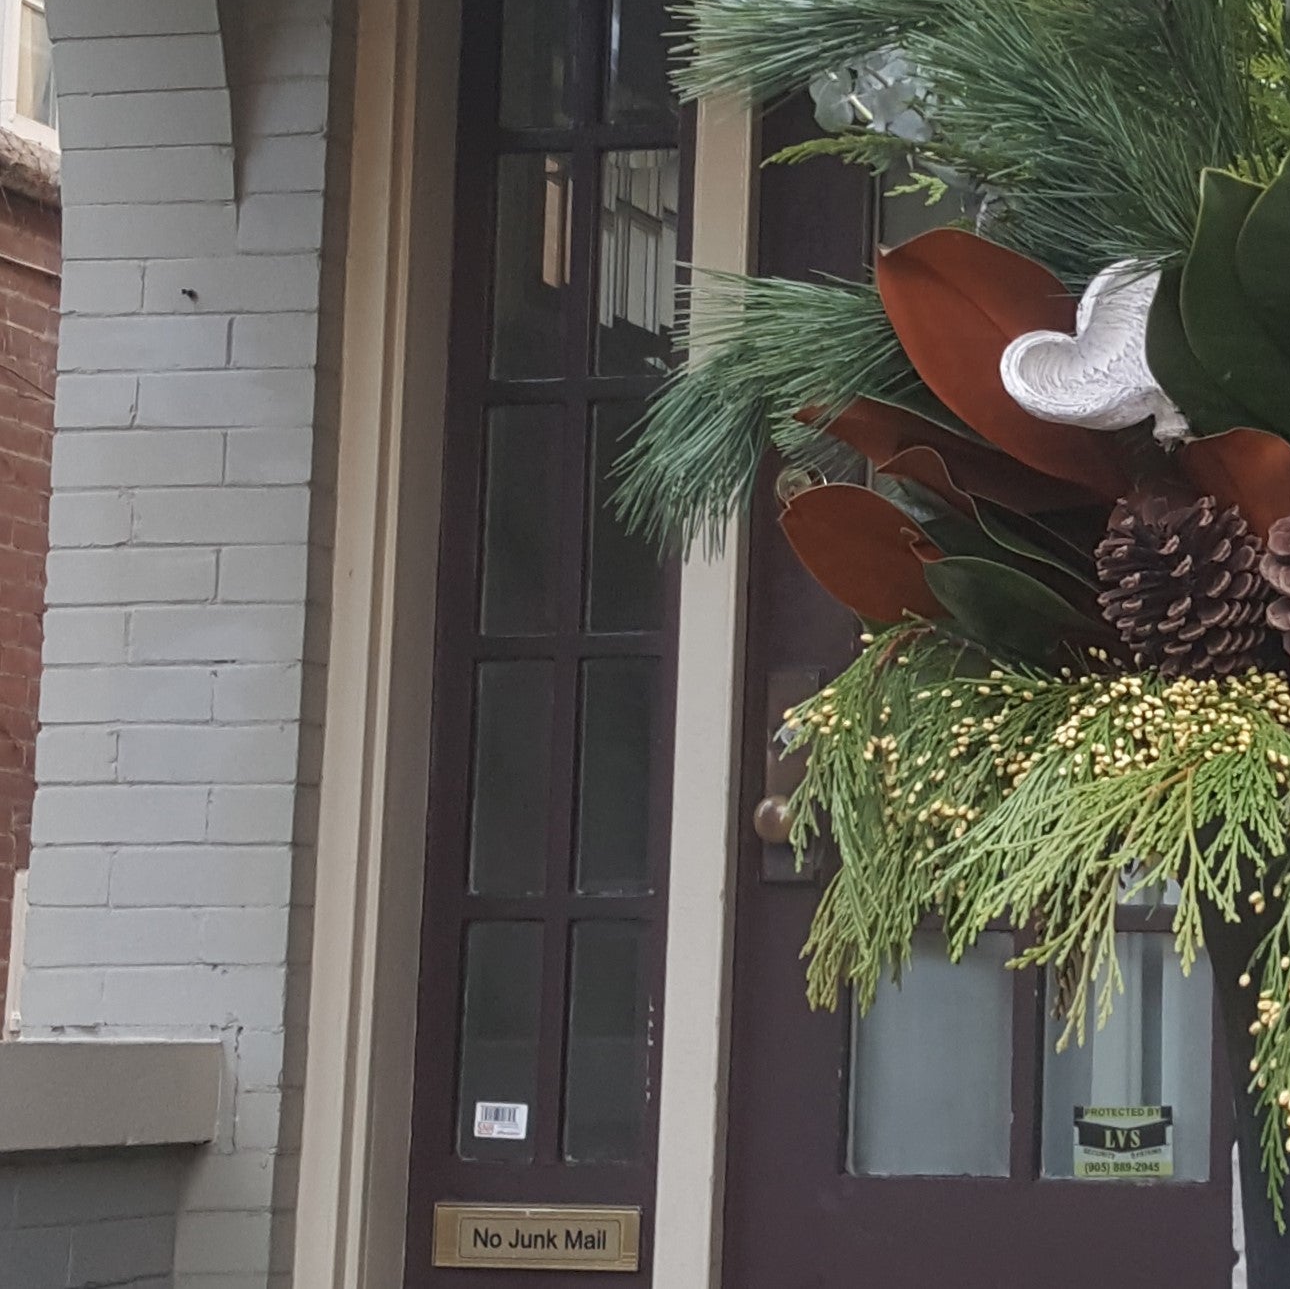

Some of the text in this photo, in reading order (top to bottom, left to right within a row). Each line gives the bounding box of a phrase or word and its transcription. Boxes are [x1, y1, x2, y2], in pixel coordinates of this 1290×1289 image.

[1085, 1107, 1161, 1117] PROTECTED BY
[1104, 1129, 1141, 1149] LVS
[1085, 1162, 1110, 1175] (905)
[473, 1228, 606, 1250] No Junk Mail
